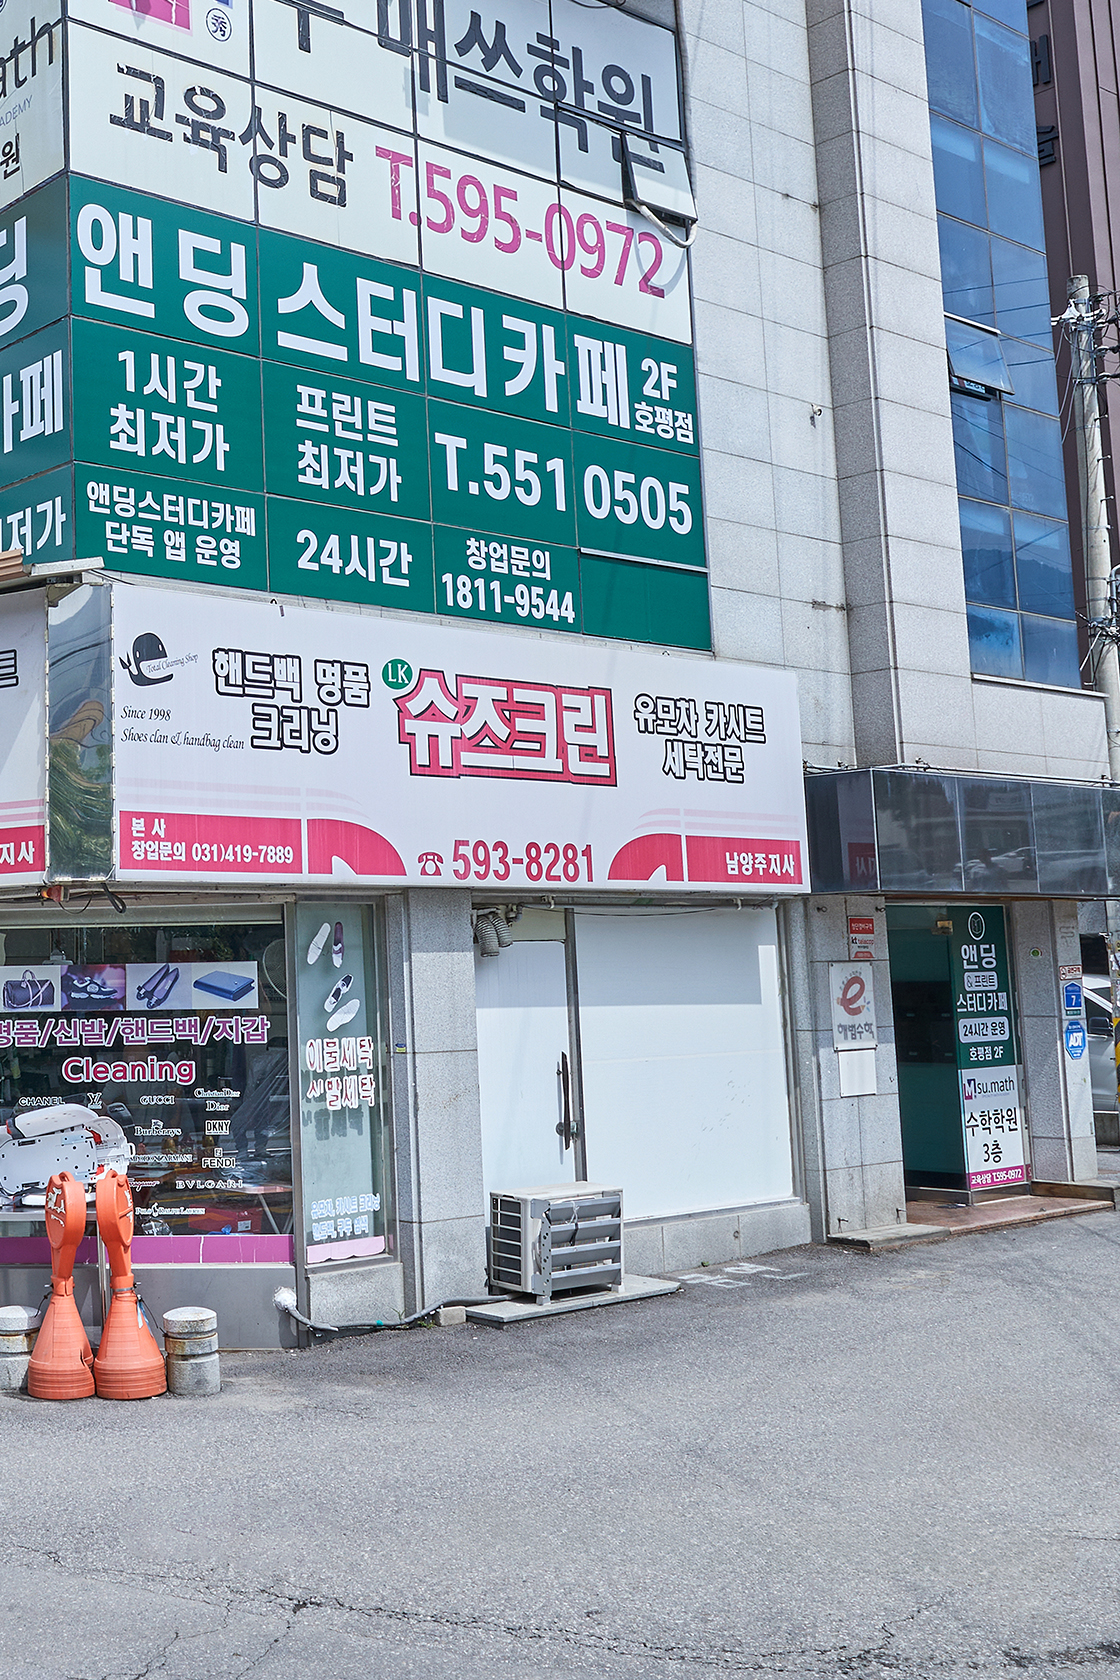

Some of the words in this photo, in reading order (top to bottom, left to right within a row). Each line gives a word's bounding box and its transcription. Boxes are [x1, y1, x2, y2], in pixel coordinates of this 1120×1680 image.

[109, 62, 353, 208] 교육상담
[375, 145, 666, 299] T.595-0972
[76, 202, 249, 338] 앤딩
[640, 357, 678, 402] 2F
[117, 350, 222, 413] 1시간
[295, 384, 400, 447] 프린트
[634, 401, 694, 445] 호평점
[109, 403, 230, 472] 최저가
[297, 440, 402, 503] 최저가
[434, 431, 567, 513] T.551
[583, 463, 694, 536] 0505
[86, 481, 257, 537] 앤딩스터디카페
[104, 520, 155, 557] 단독
[164, 530, 187, 560] 앱
[195, 535, 243, 570] 운영
[296, 529, 413, 588] 24시간
[465, 538, 552, 581] 창업문의
[441, 572, 576, 624] 1811-9544
[211, 647, 303, 702] 핸드백
[313, 659, 372, 709] 명품
[120, 705, 146, 720] Since
[148, 707, 172, 721] 1998
[250, 700, 339, 756] 크리닝
[399, 670, 614, 784] 슈즈크린
[632, 692, 700, 738] 유모차
[705, 701, 767, 747] 카시트
[120, 726, 148, 742] Shoes
[149, 728, 169, 744] clan
[183, 731, 221, 752] handbag
[222, 734, 245, 750] clean
[662, 737, 746, 783] 세탁전문
[131, 839, 187, 863] 창업문의
[191, 842, 294, 866] 031)419-7889
[451, 839, 594, 883] 593-8281
[724, 850, 796, 877] 남양주지사
[960, 943, 997, 970] 앤딩
[974, 974, 996, 988] 프린트
[956, 991, 1008, 1012] 스터디카페
[837, 1021, 875, 1040] 해법수학
[962, 1022, 989, 1037] 24시간
[990, 1021, 1006, 1036] 운영
[62, 1056, 196, 1084] Cleaning
[306, 1036, 374, 1071] 이불세탁
[969, 1045, 992, 1061] 호평점
[993, 1045, 1004, 1059] 2F
[18, 1096, 65, 1106] CHANEL
[139, 1095, 175, 1106] GUCCI
[976, 1075, 1015, 1095] su.math
[205, 1100, 230, 1112] Dior
[965, 1106, 1019, 1137] 수학학원
[134, 1126, 182, 1137] Burberrys
[206, 1120, 230, 1132] DKNY
[201, 1158, 236, 1169] FENDI
[982, 1139, 1003, 1163] 3층
[175, 1180, 244, 1189] BVLGARI
